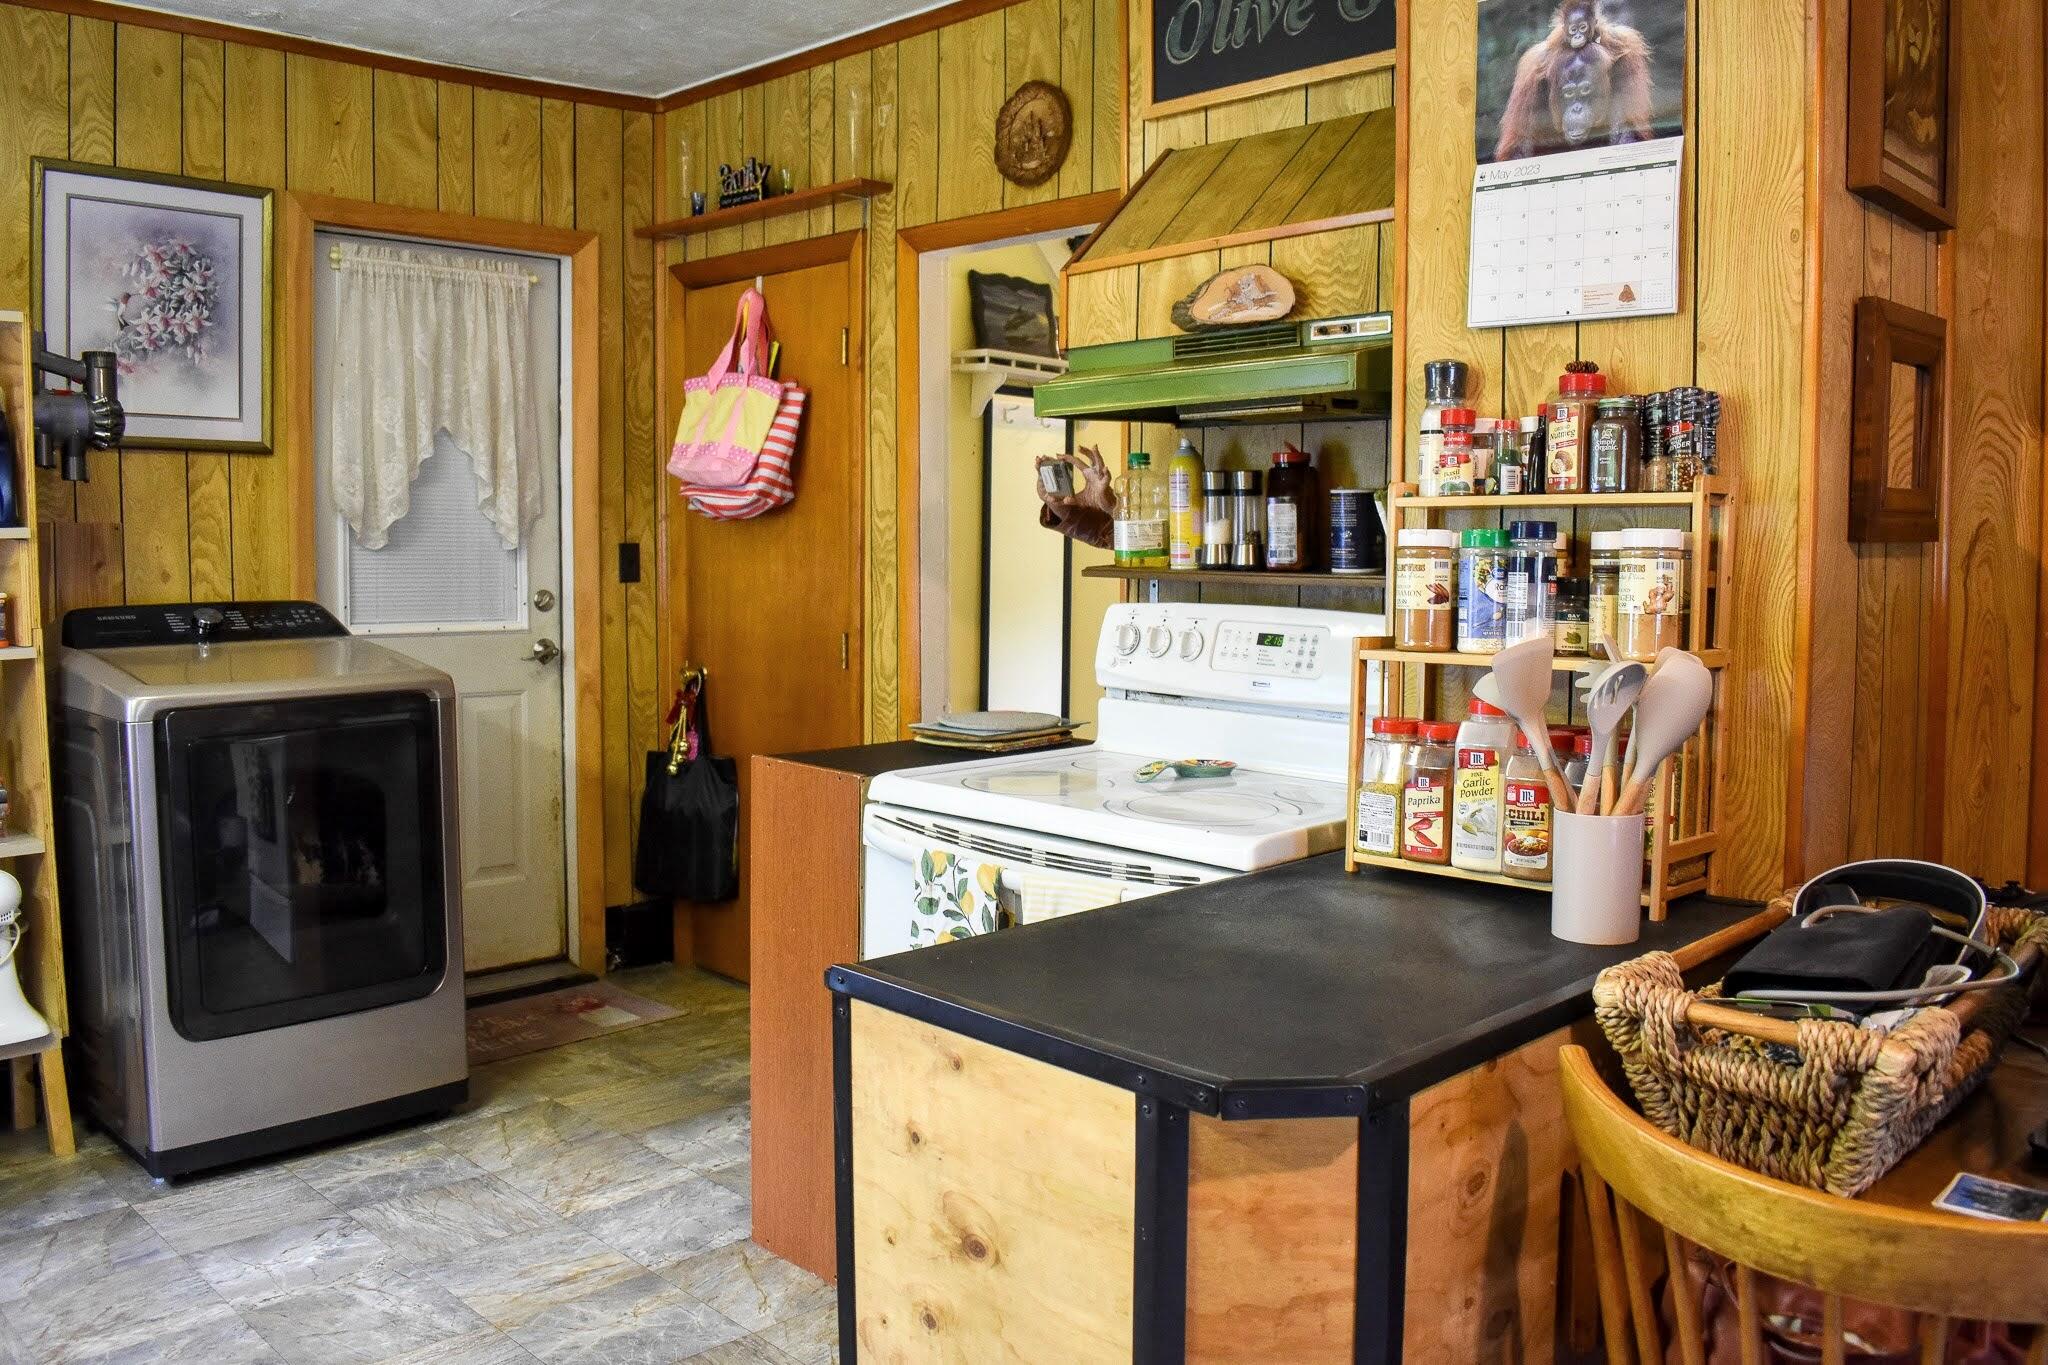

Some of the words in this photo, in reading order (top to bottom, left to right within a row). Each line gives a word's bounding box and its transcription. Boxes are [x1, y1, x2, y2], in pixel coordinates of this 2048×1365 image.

[1166, 0, 1316, 64] Olive
[1490, 170, 1512, 180] May
[1514, 164, 1540, 177] 2023
[1550, 430, 1576, 440] Nutmeg
[1462, 777, 1491, 788] Garlic
[1460, 787, 1494, 798] Powder
[1408, 795, 1440, 807] Paprika
[1508, 809, 1545, 821] CHILI
